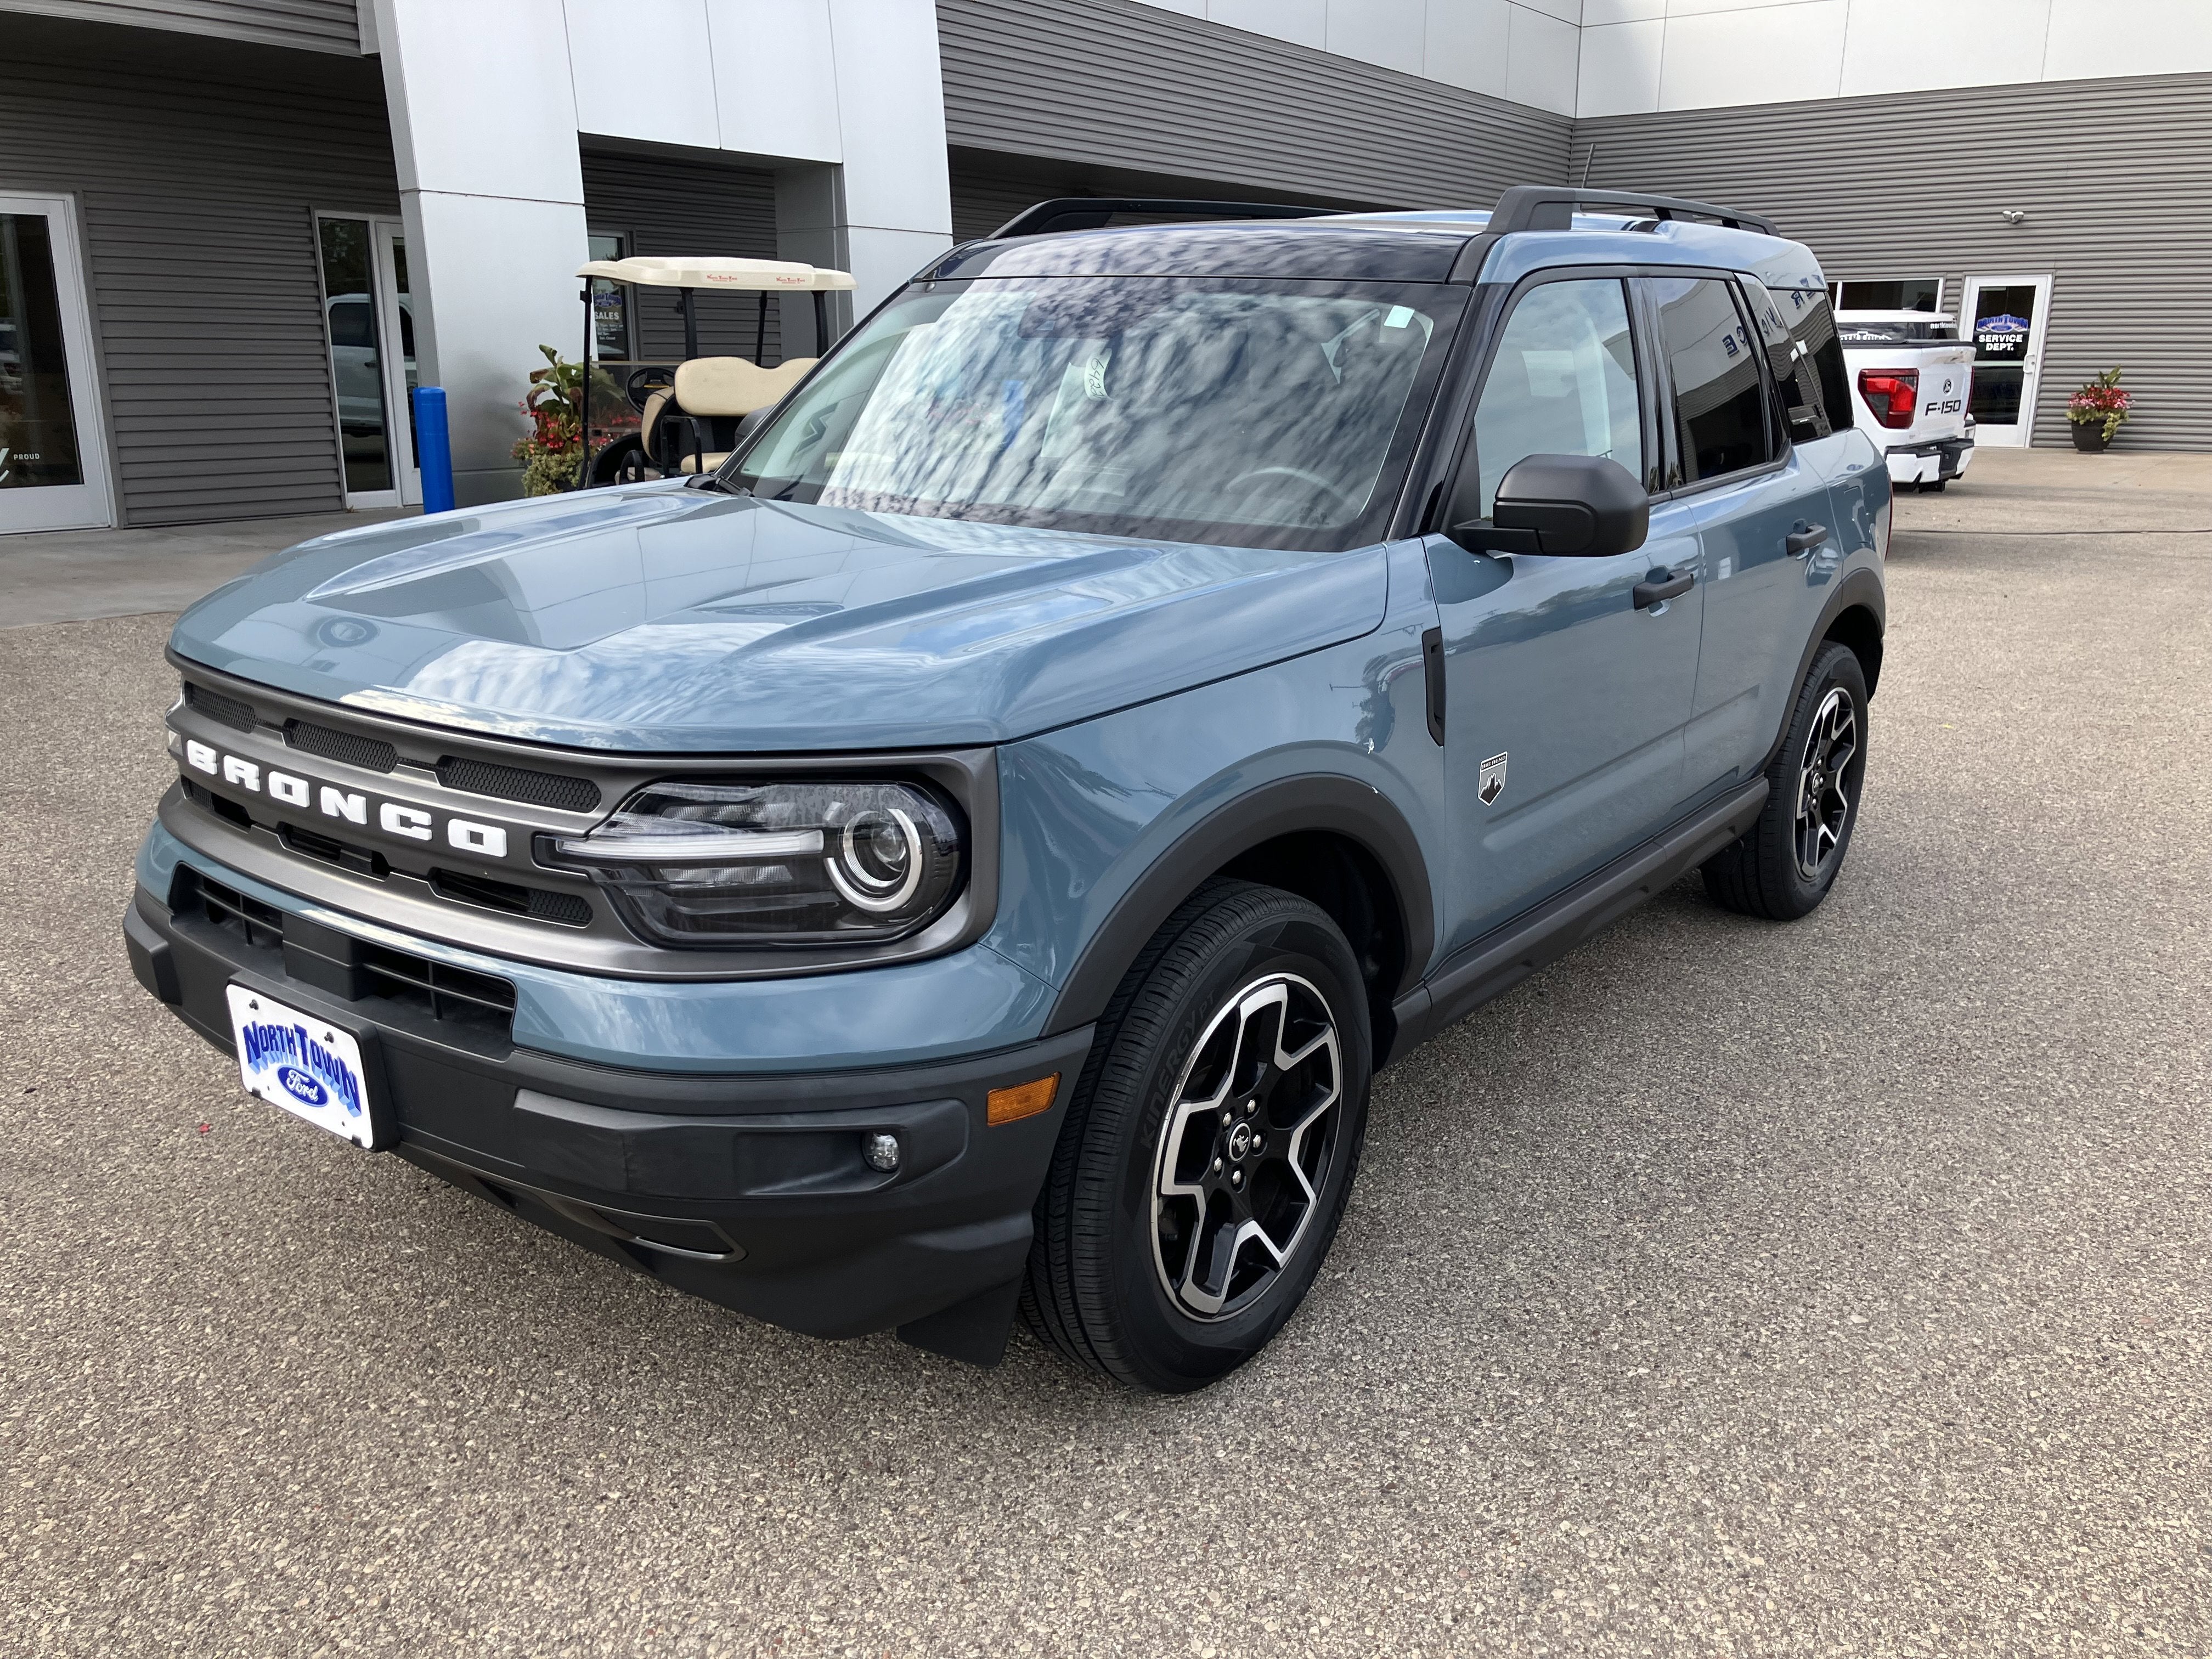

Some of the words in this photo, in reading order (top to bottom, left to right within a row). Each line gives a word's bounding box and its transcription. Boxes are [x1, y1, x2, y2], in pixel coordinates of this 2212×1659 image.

[595, 312, 619, 320] SALES
[1978, 334, 2023, 342] SERVICE
[1492, 755, 1506, 765] BEND
[187, 739, 507, 857] BRONCO
[1141, 1009, 1196, 1148] KINERGY
[1199, 989, 1215, 1020] PT
[286, 1069, 319, 1102] Ford
